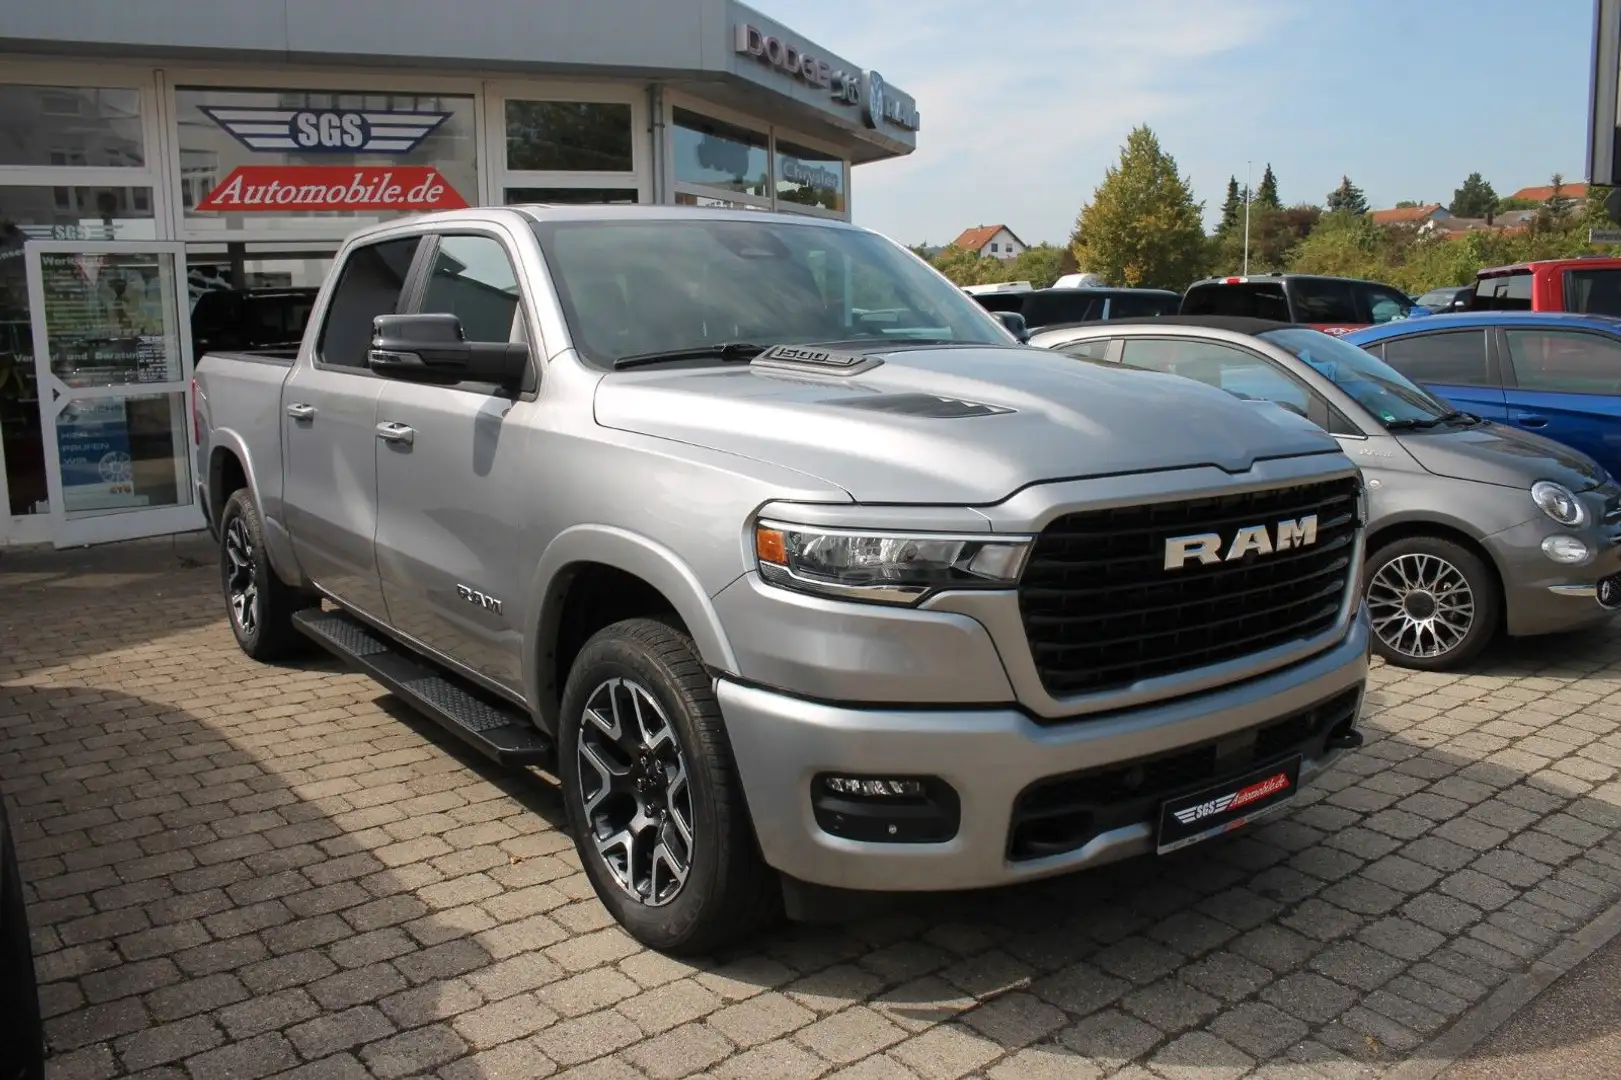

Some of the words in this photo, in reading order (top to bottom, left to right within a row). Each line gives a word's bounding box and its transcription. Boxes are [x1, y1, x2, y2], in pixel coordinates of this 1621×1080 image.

[735, 25, 830, 88] DODGE
[297, 112, 363, 147] SGS
[211, 172, 444, 205] Automobile.de
[54, 225, 88, 240] SGS
[1164, 514, 1318, 571] RAM
[1195, 800, 1217, 820] SGS
